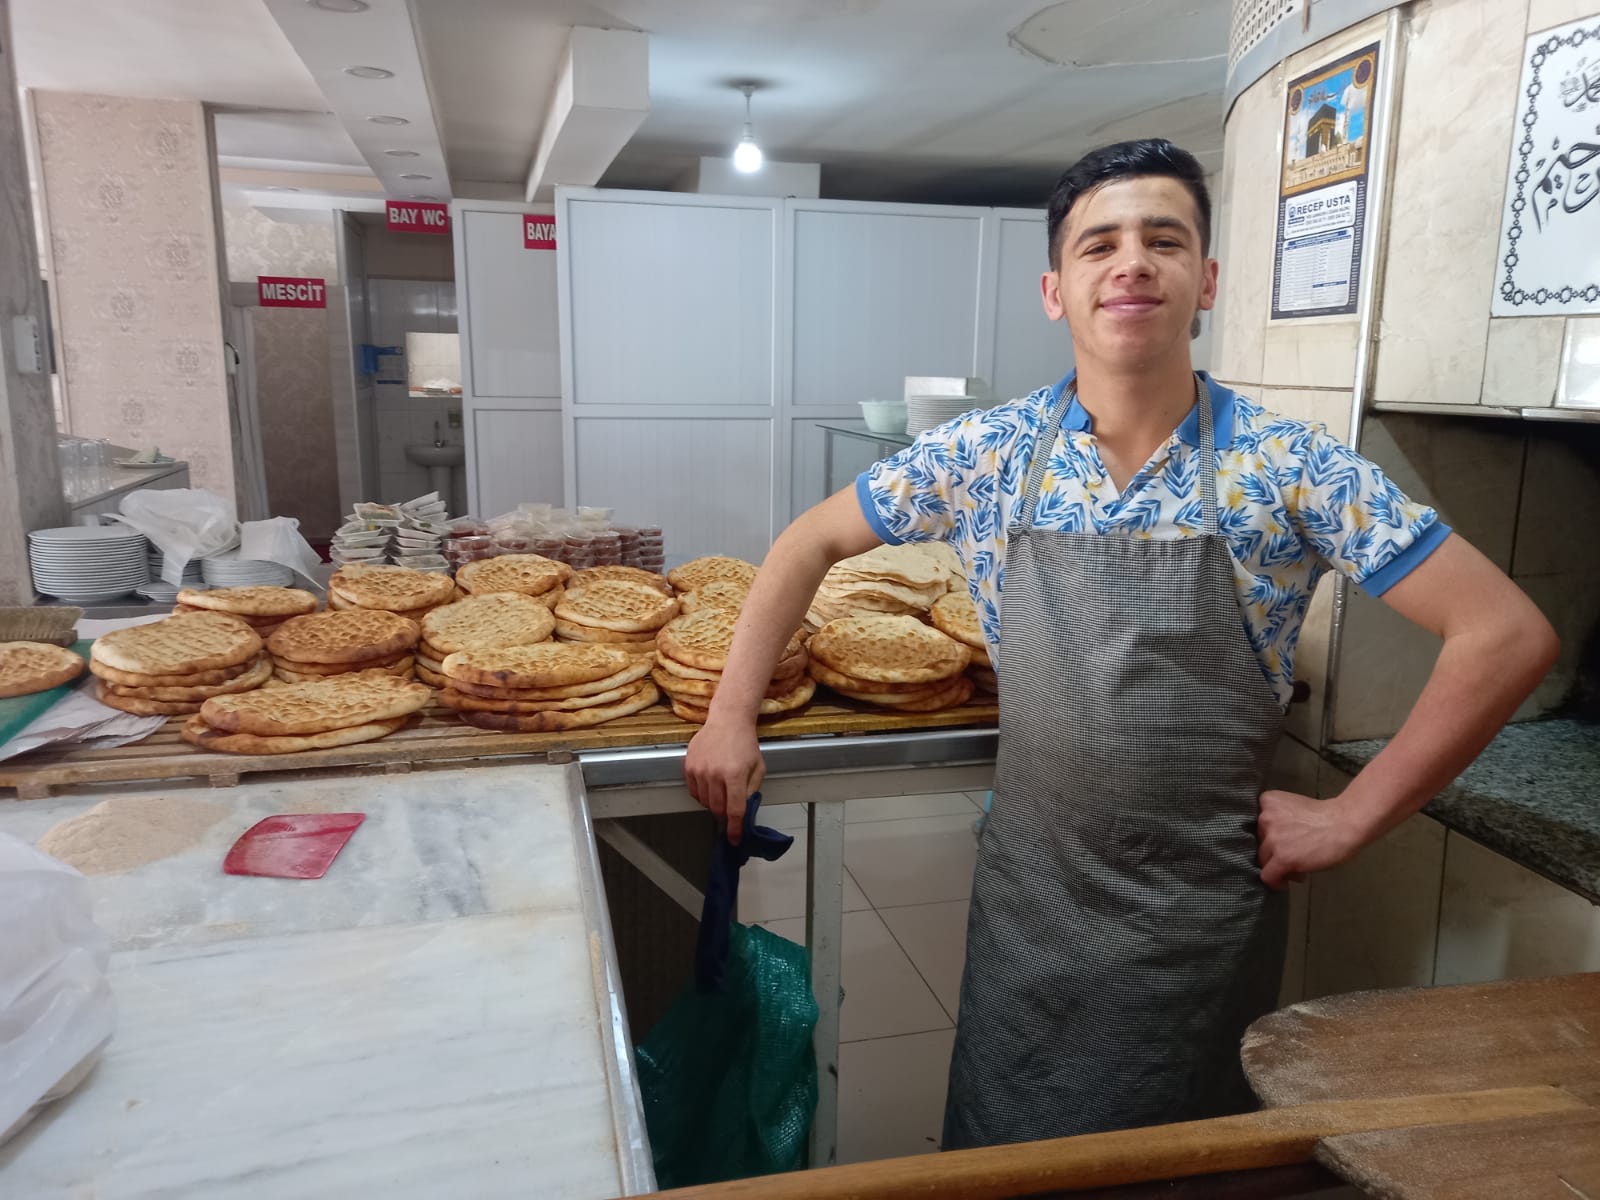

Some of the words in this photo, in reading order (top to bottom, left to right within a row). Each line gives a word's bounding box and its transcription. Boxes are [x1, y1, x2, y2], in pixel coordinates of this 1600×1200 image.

[1297, 201, 1324, 215] RECEP
[1326, 194, 1351, 208] USTA
[389, 207, 418, 225] BAY
[422, 209, 445, 226] WC
[261, 281, 323, 302] MESCİT
